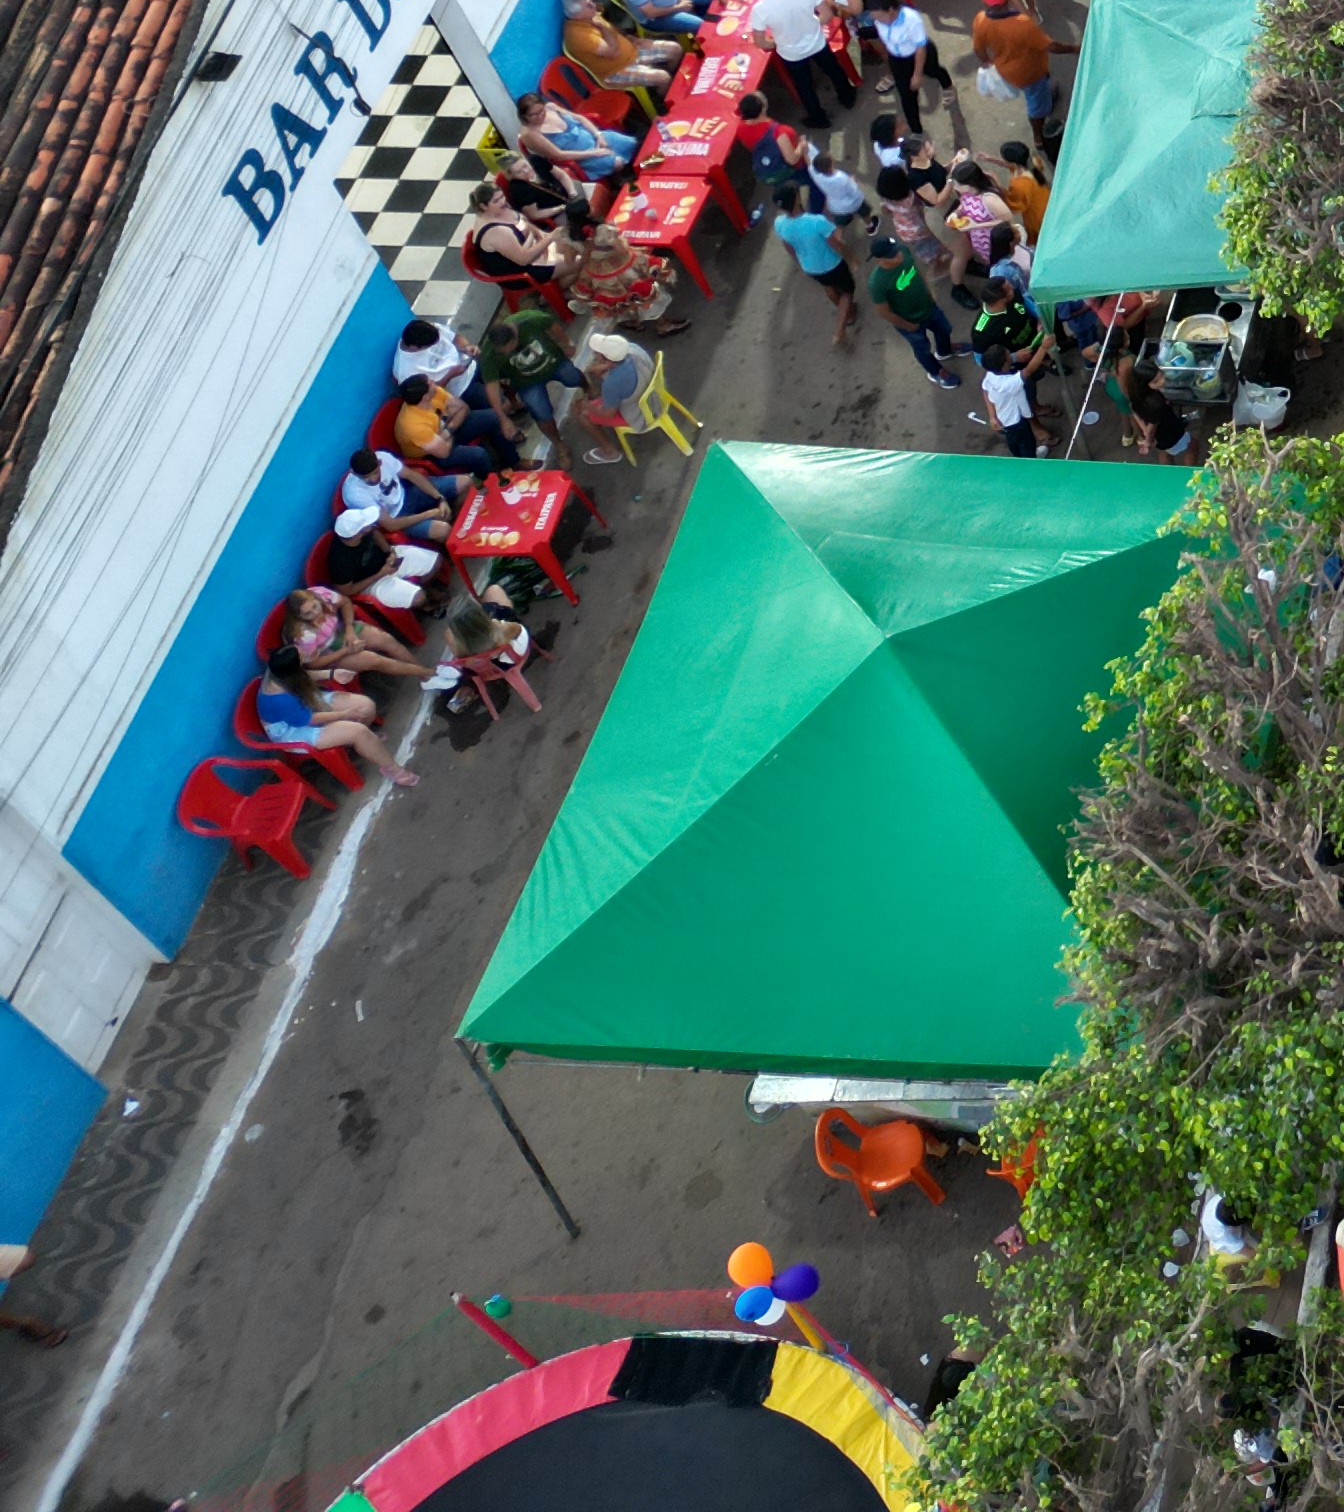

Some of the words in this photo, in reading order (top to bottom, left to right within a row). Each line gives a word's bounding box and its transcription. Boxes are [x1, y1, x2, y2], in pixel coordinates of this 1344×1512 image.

[690, 56, 722, 95] BRAHMA
[221, 29, 357, 246] BAR
[534, 492, 557, 530] ITAIPAVA
